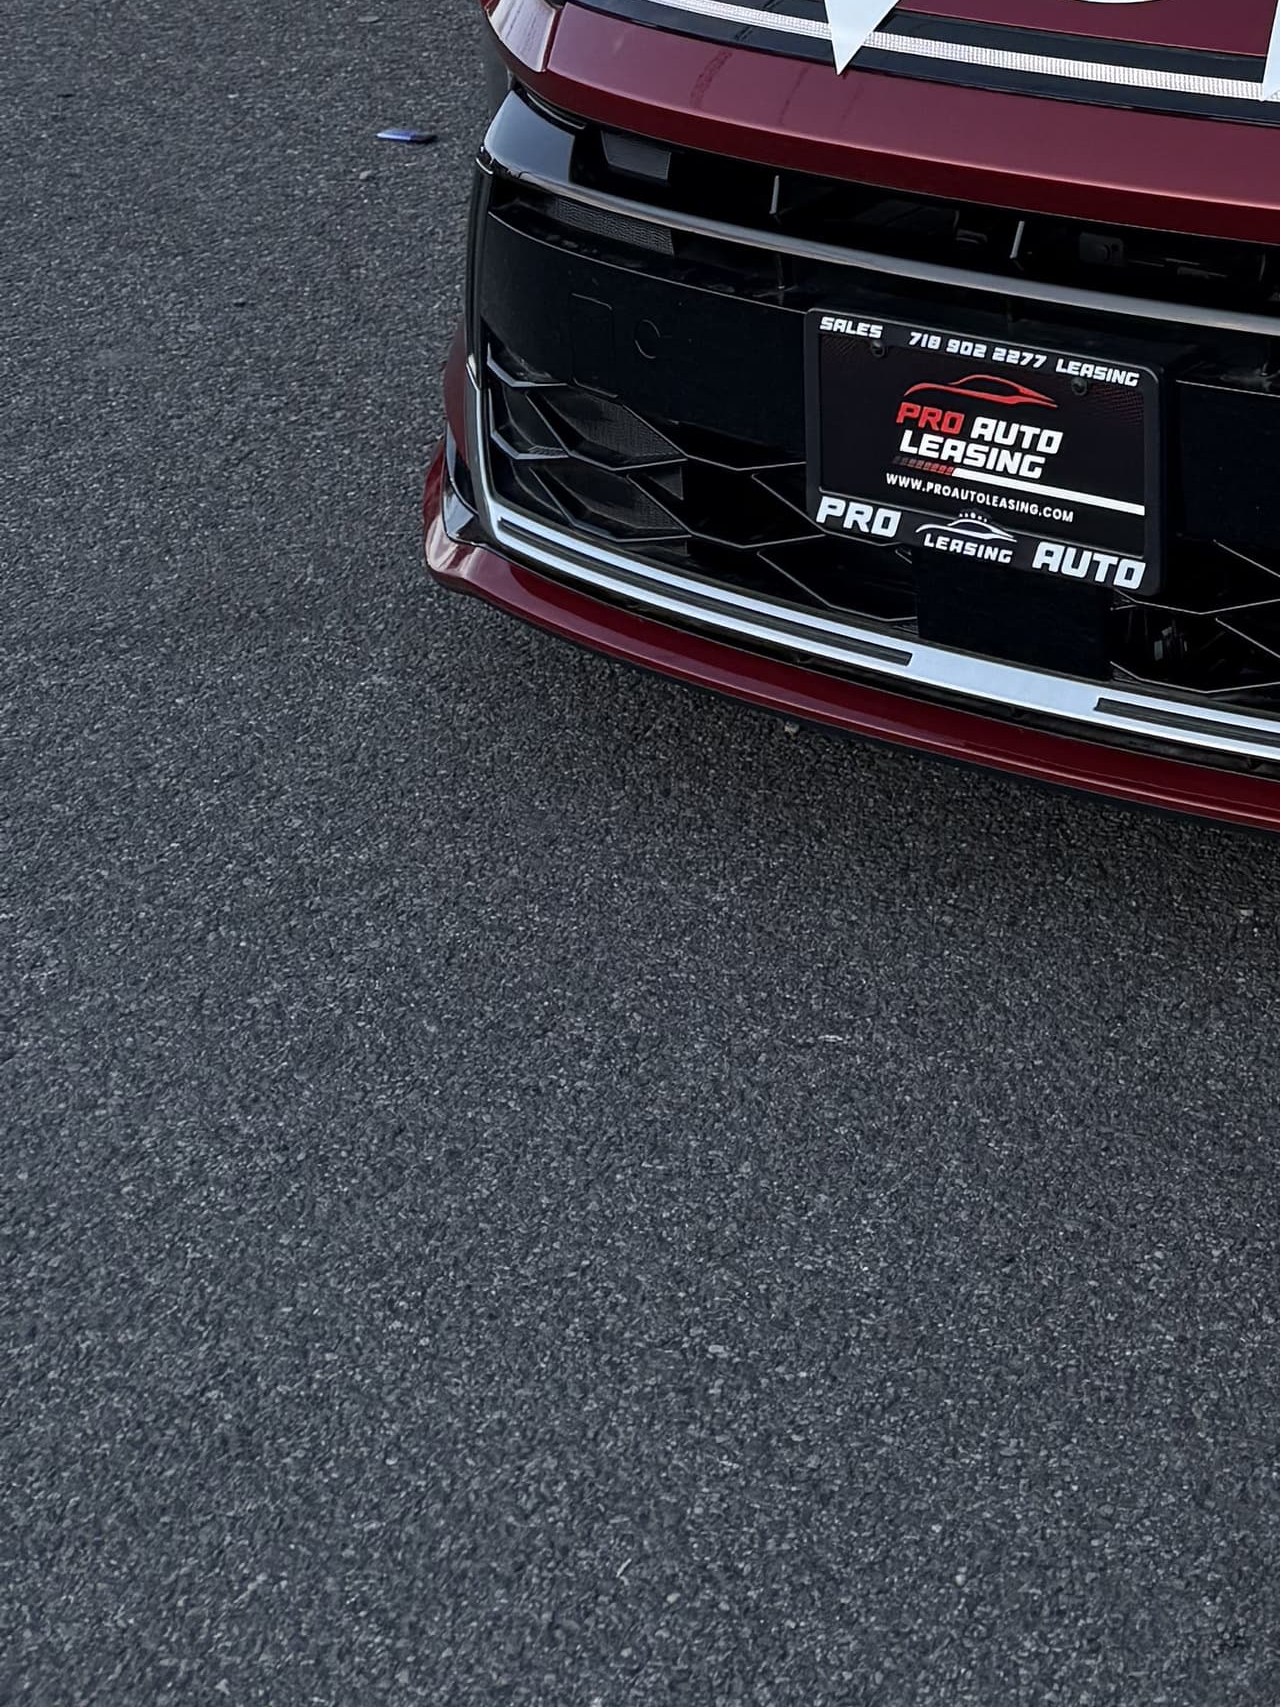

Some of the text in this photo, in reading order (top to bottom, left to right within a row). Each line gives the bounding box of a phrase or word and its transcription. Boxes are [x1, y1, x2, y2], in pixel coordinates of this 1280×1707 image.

[819, 315, 884, 339] SALES
[909, 331, 1047, 368] 718 902 2277
[1055, 357, 1141, 387] LEASING
[896, 401, 1064, 456] PRO AUTO
[899, 429, 1047, 480] LEASING
[815, 495, 902, 539] PRO
[885, 471, 1075, 524] WWW.PROAUTOLEASING.COM
[923, 532, 1014, 565] LEASING
[1031, 540, 1147, 590] AUTO
